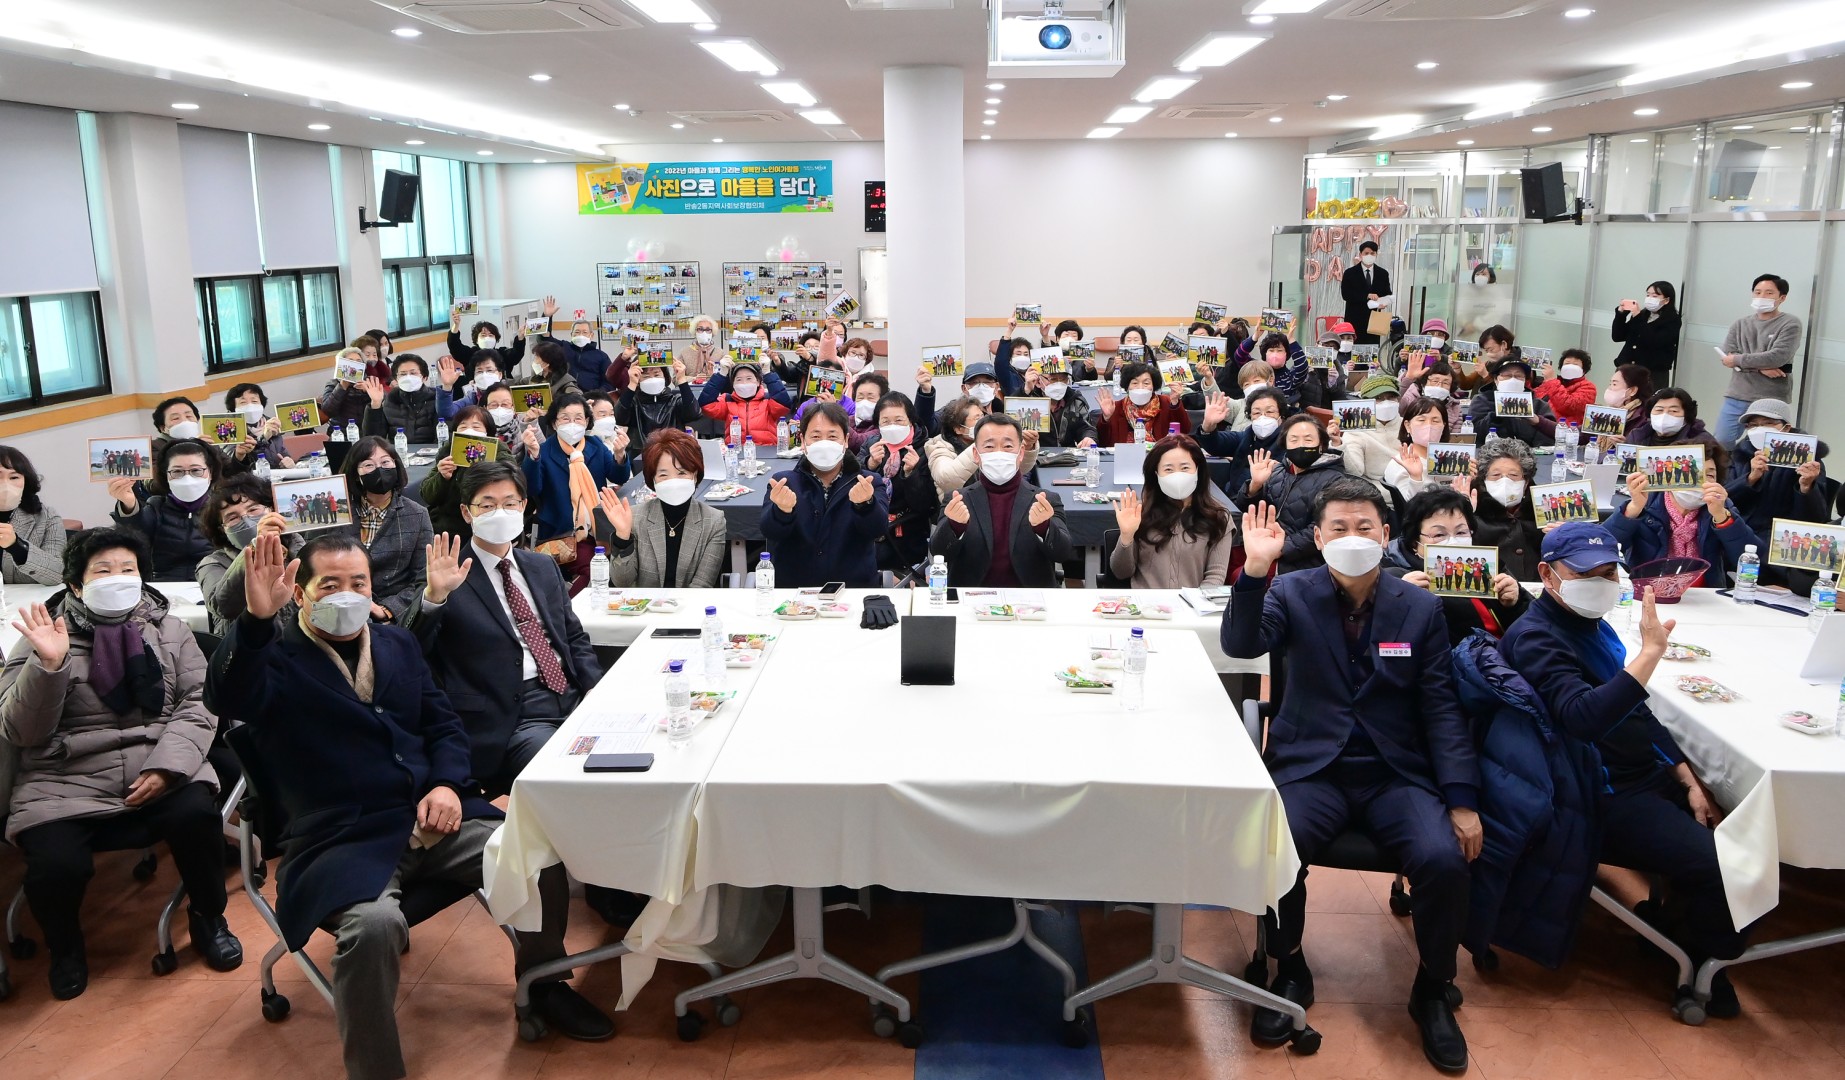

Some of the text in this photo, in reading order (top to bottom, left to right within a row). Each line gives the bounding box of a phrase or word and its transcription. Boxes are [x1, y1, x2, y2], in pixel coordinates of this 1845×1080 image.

[721, 166, 741, 174] 그리는
[645, 177, 816, 197] 사진으로 마을을 담다
